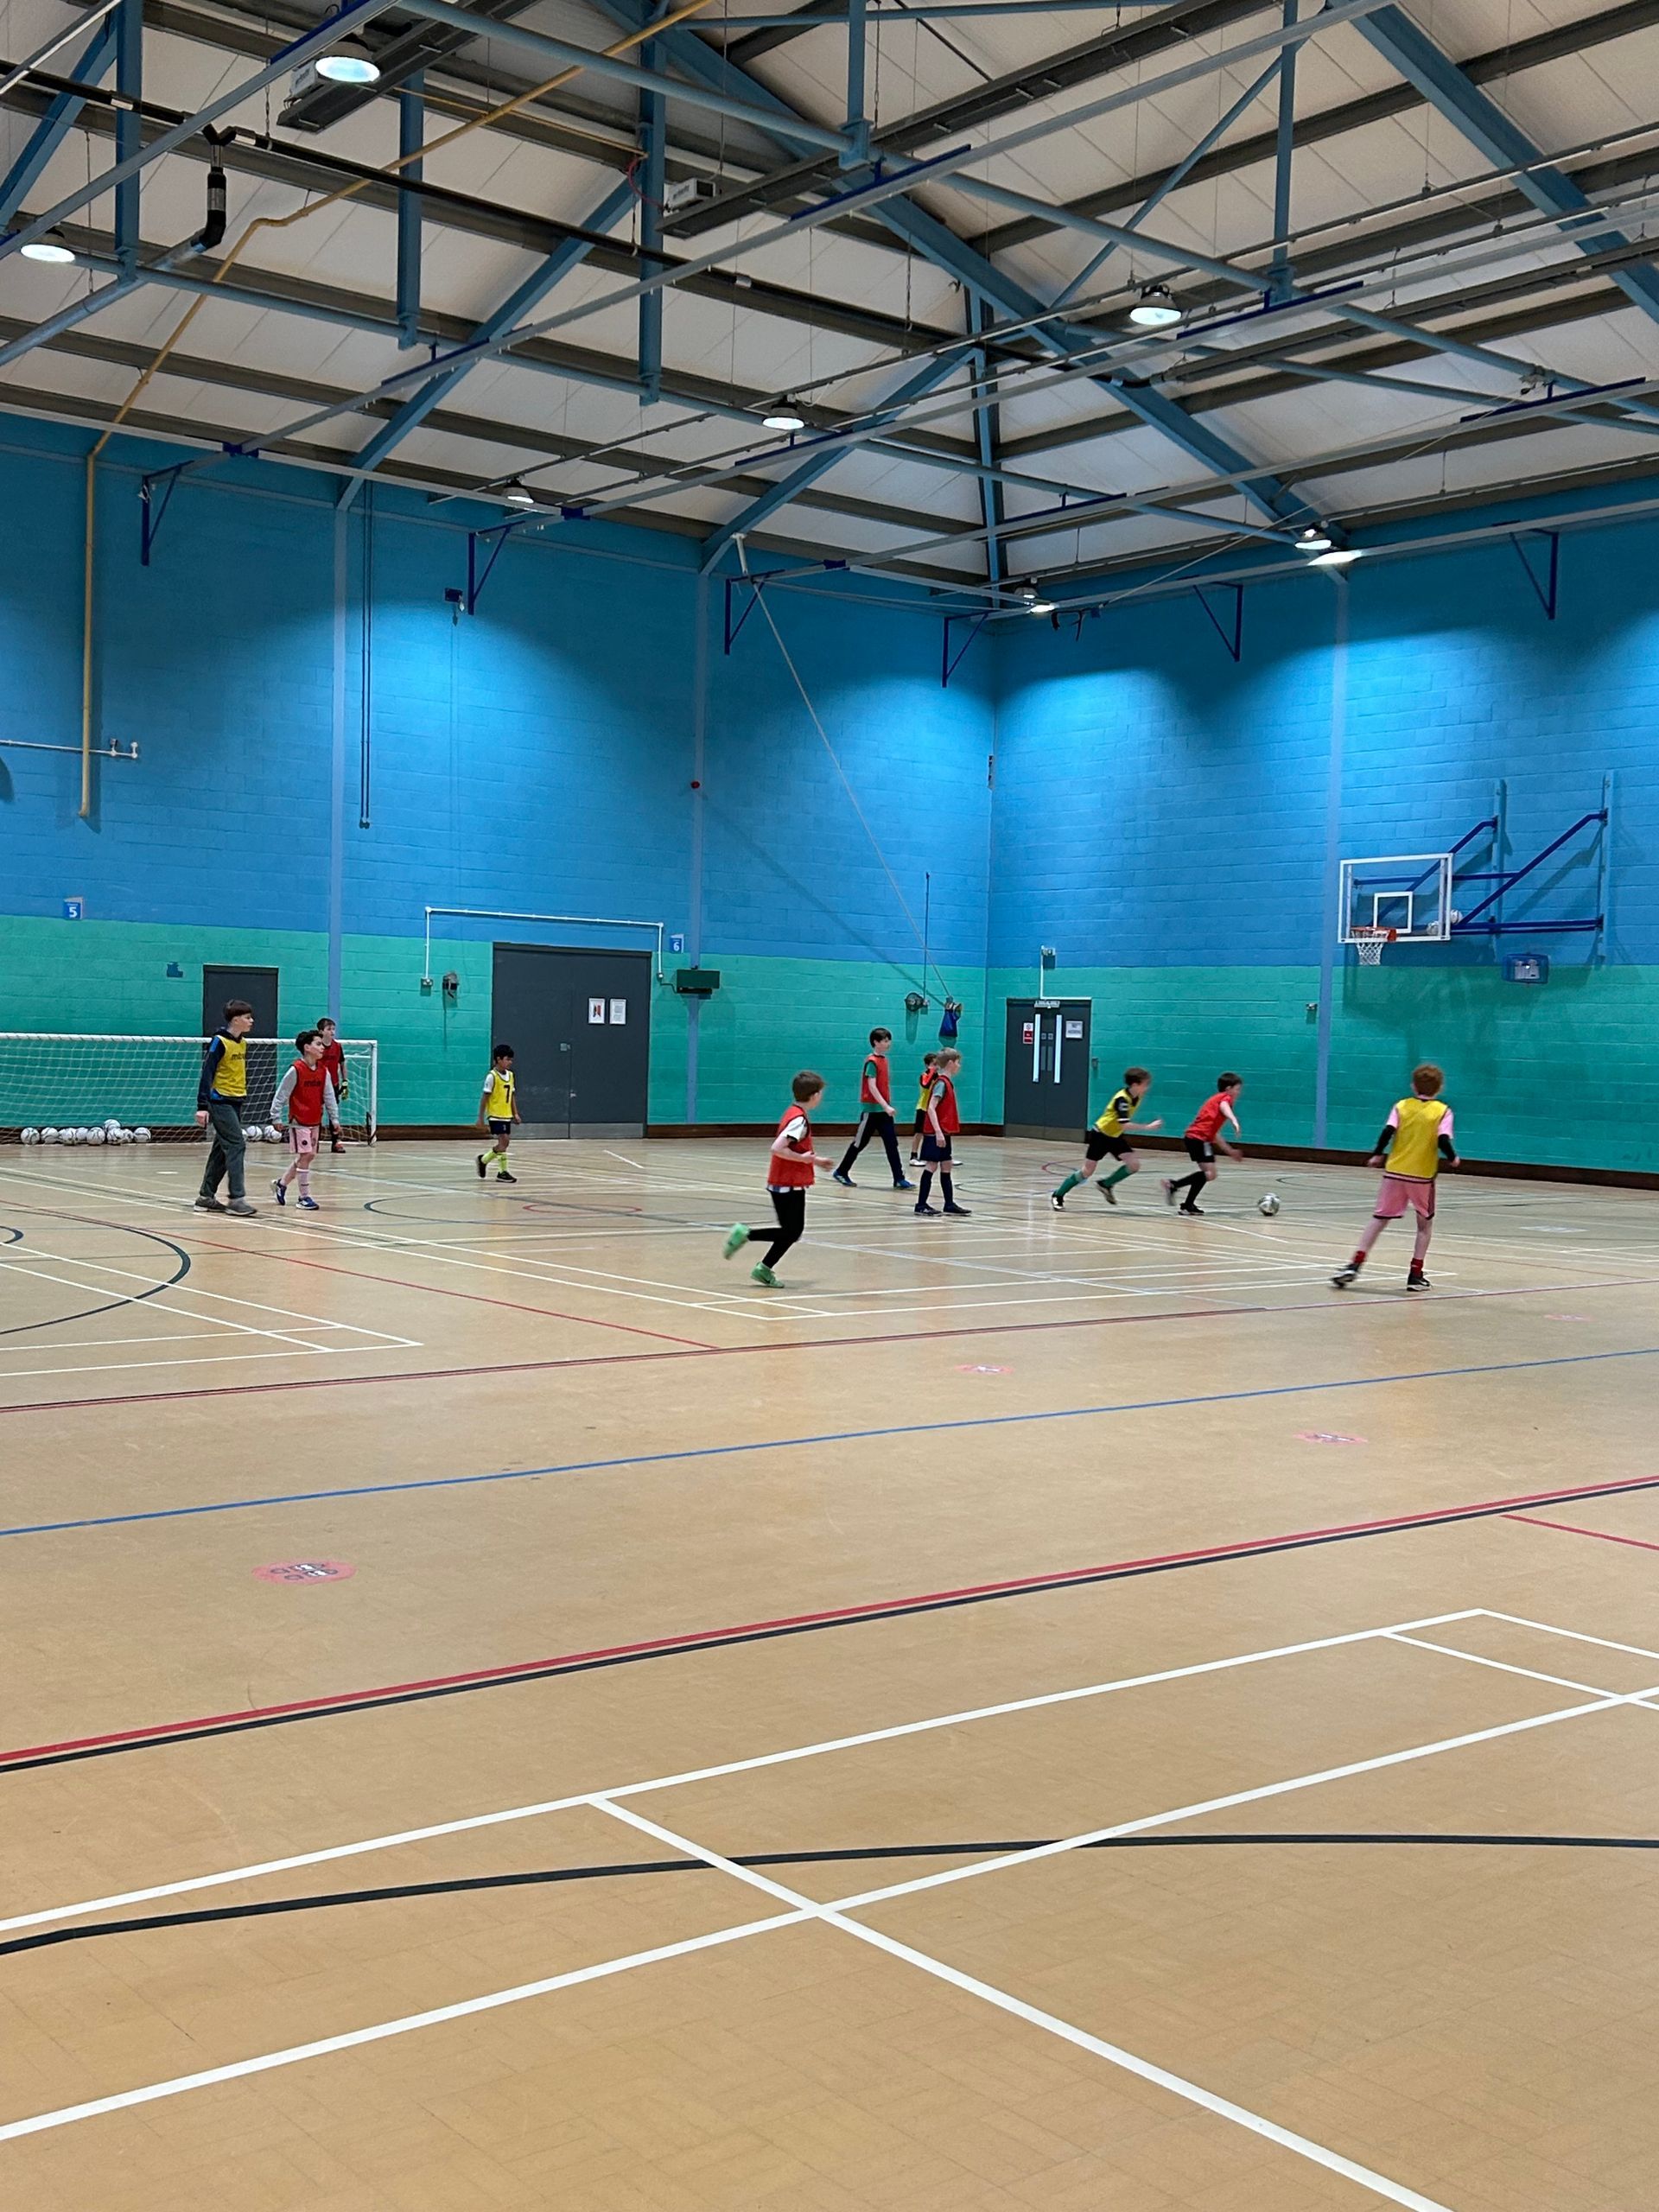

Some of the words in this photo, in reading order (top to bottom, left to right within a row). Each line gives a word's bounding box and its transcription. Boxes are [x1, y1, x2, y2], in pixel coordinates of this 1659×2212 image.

[69, 906, 78, 918] 5
[673, 942, 680, 951] 6
[504, 1085, 510, 1103] 7
